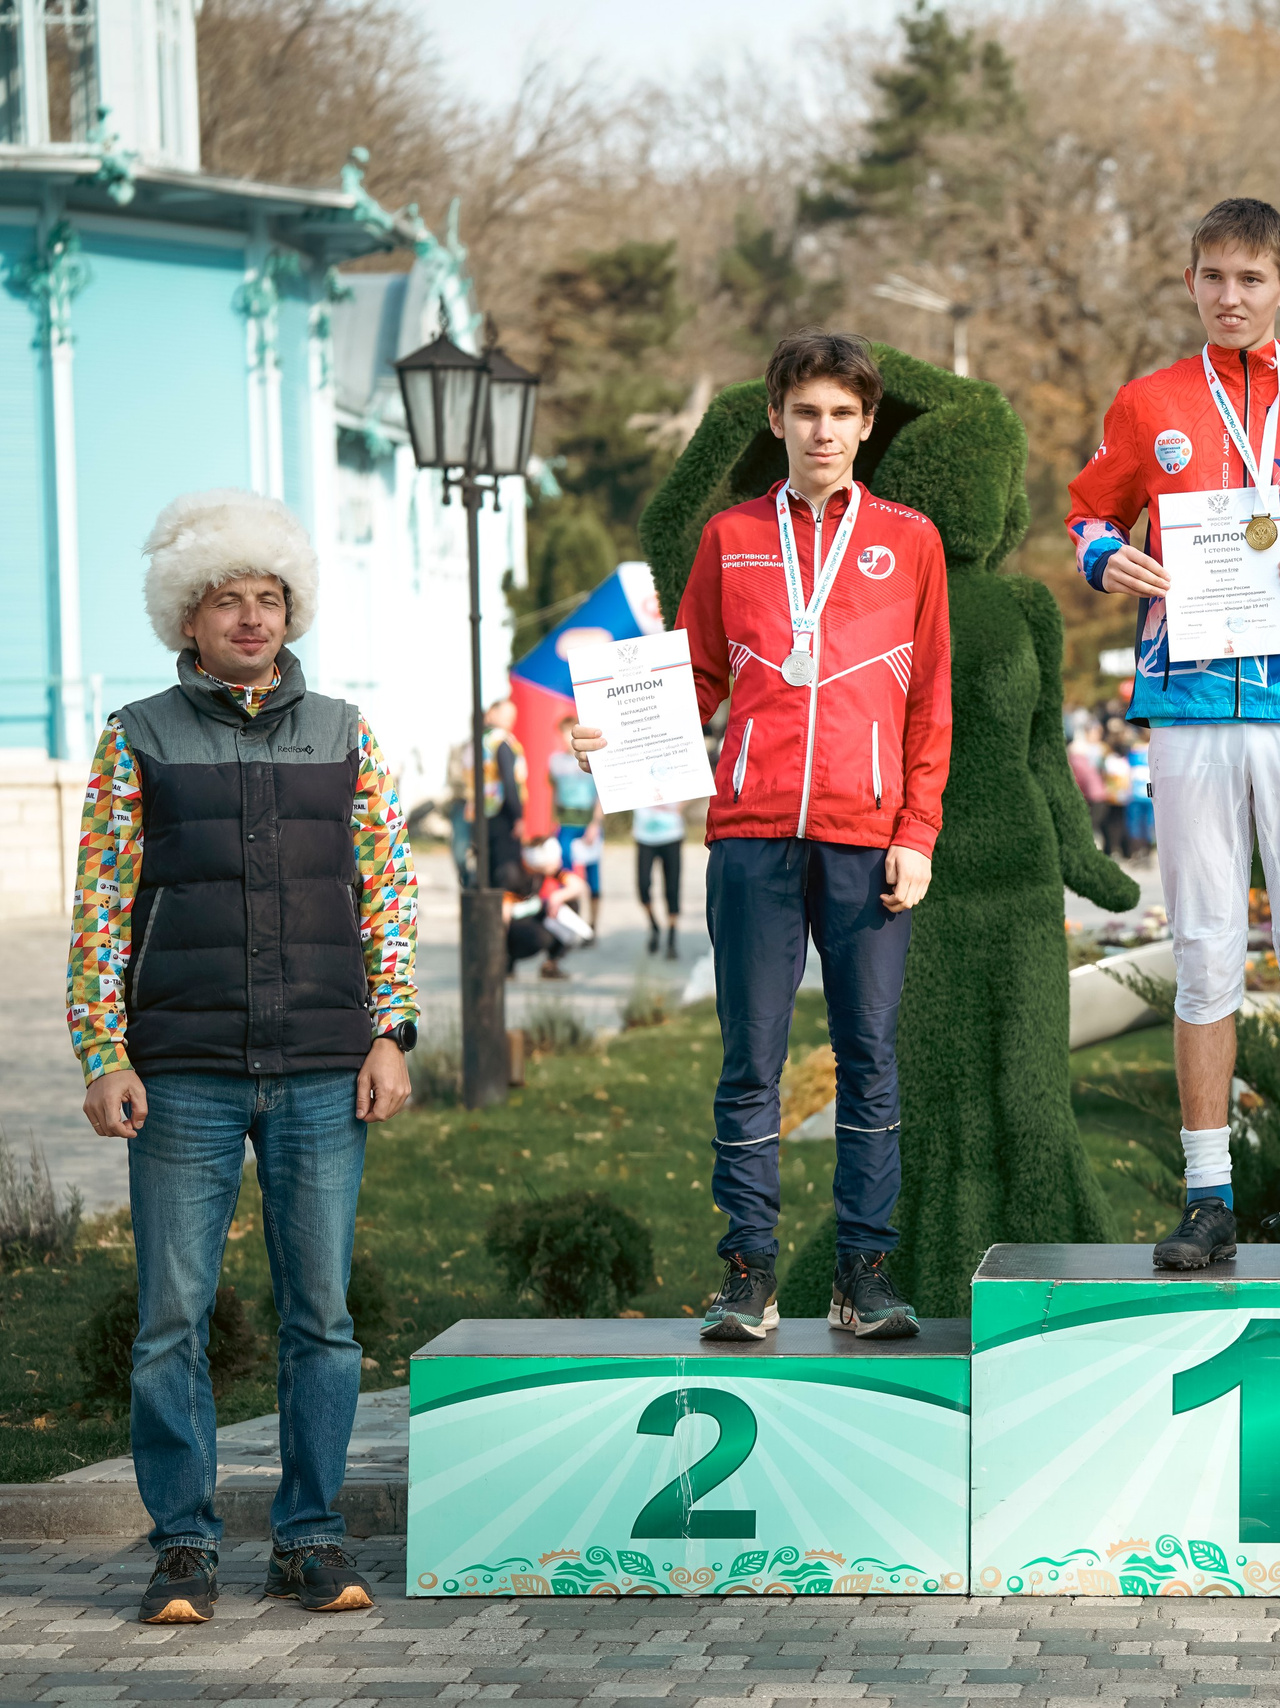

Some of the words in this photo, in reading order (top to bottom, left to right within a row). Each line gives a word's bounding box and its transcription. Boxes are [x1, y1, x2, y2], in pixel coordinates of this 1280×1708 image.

[607, 678, 663, 699] ДИПЛОМ
[624, 695, 655, 705] степень
[278, 745, 306, 753] RedFox
[630, 1387, 758, 1539] 2
